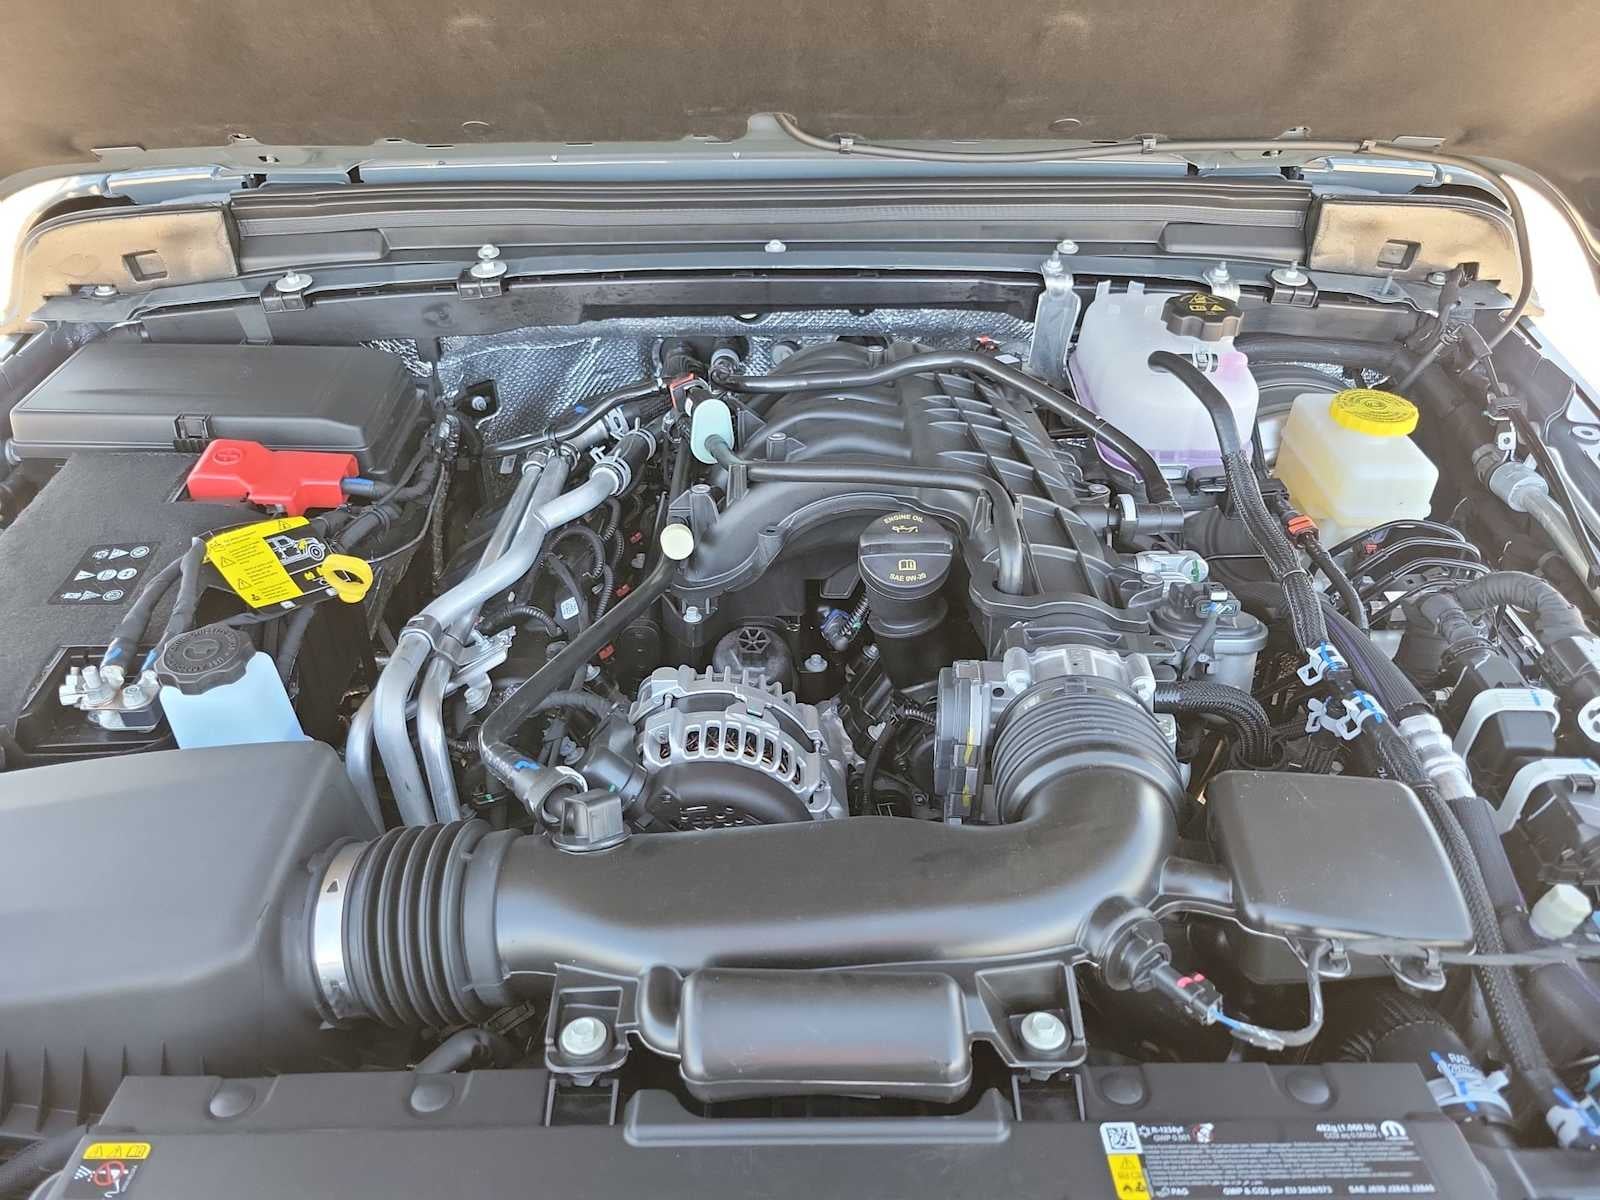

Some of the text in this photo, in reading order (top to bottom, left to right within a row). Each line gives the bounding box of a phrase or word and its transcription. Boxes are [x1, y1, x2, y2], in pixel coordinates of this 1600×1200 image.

[883, 514, 924, 524] ENGINE OIL
[889, 572, 927, 582] SAE 0W-20
